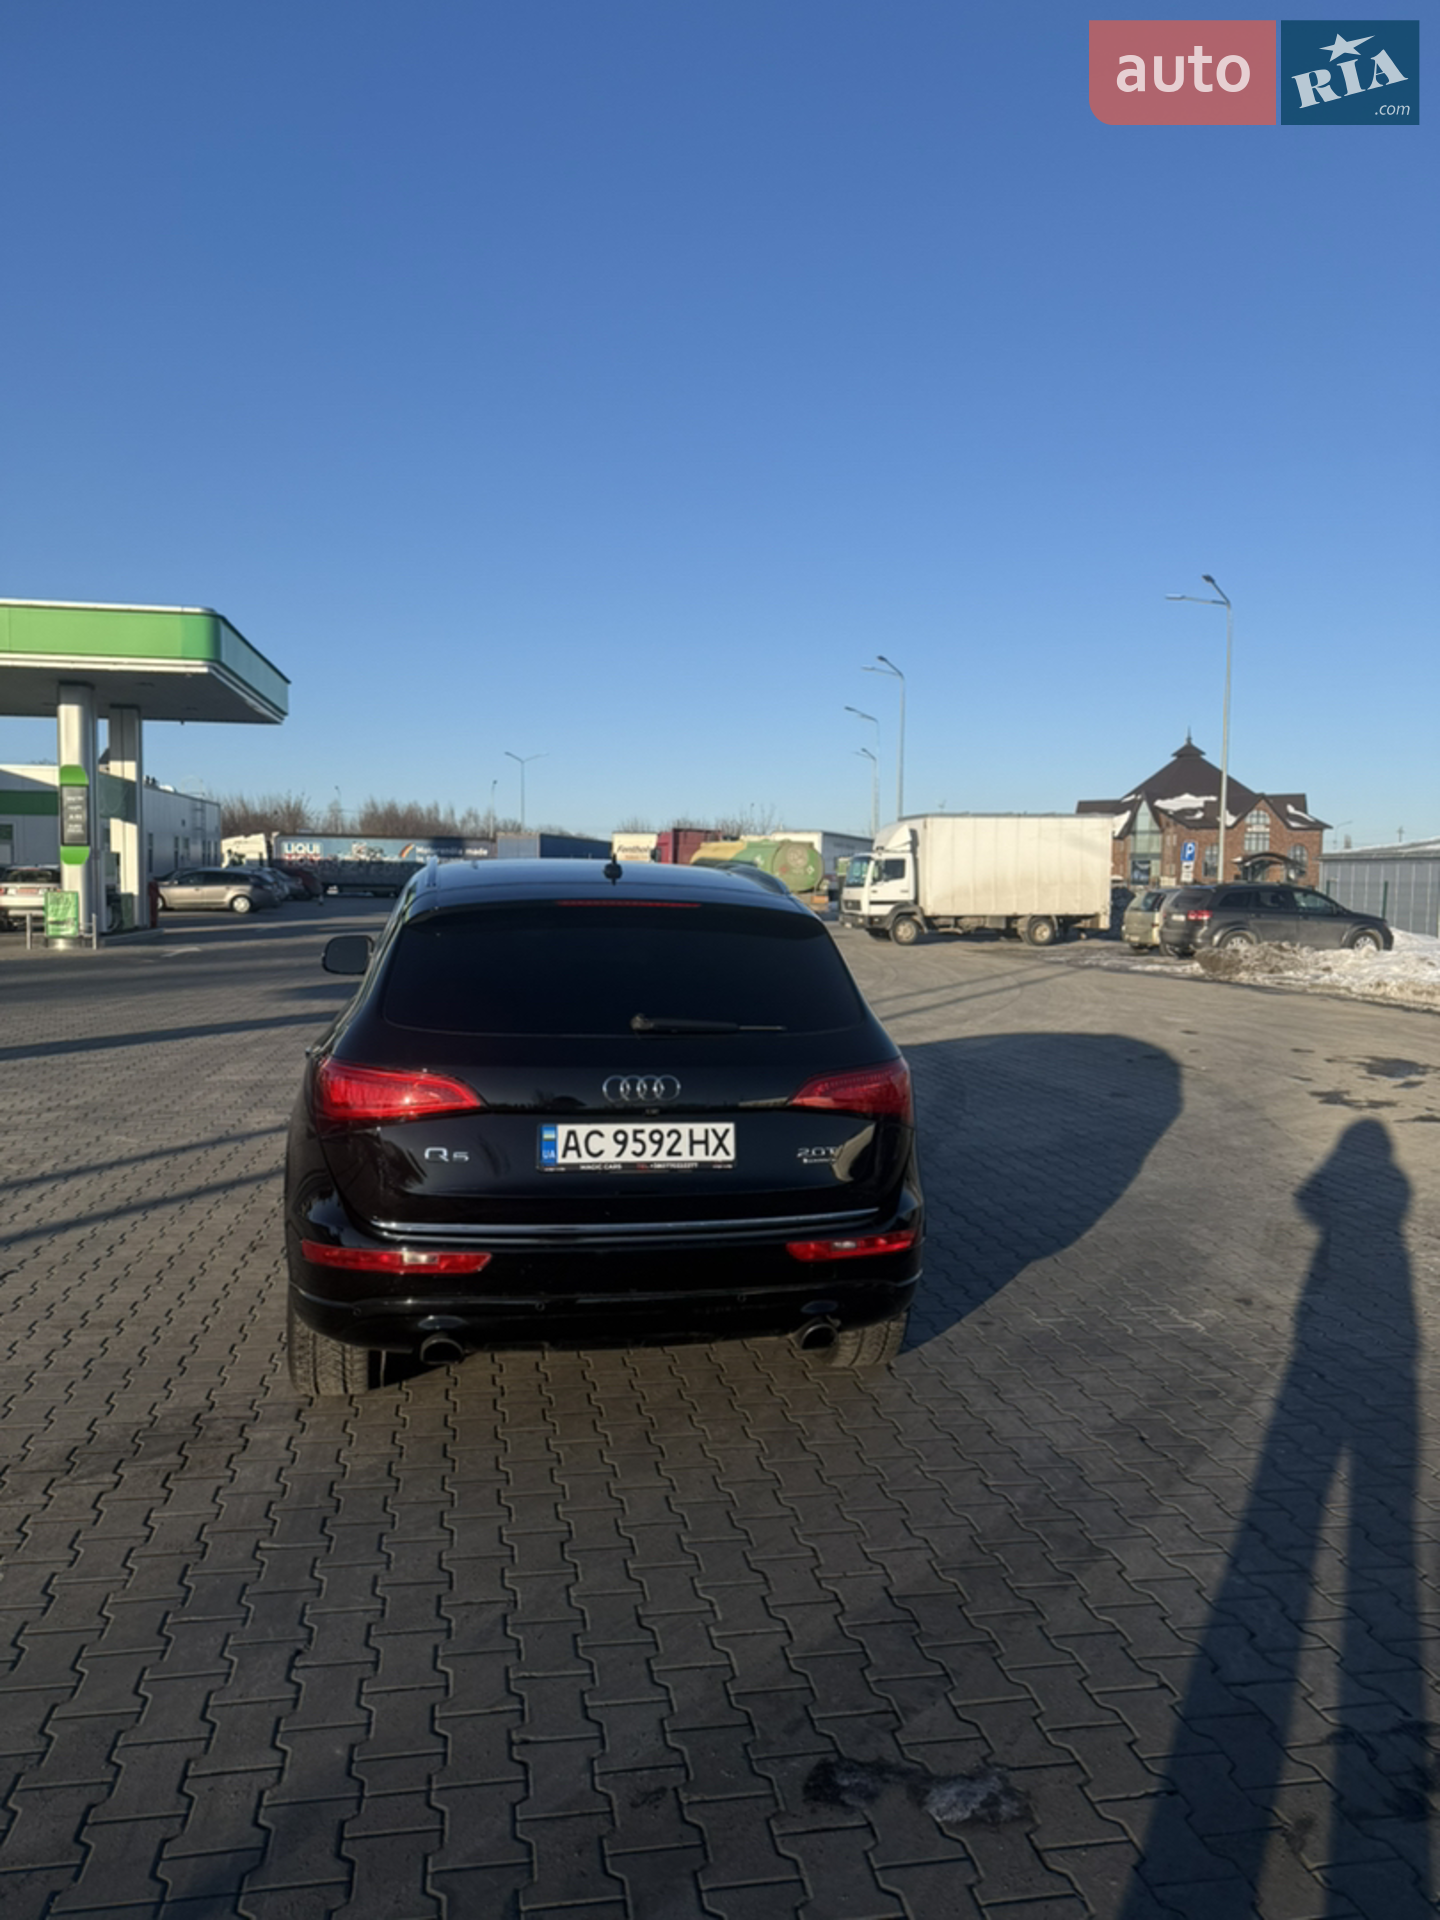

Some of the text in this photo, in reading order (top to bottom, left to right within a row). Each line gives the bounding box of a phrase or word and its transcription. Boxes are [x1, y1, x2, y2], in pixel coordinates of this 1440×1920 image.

[1185, 843, 1195, 859] P
[561, 1128, 731, 1158] AC 9592 HX
[542, 1149, 556, 1160] UA
